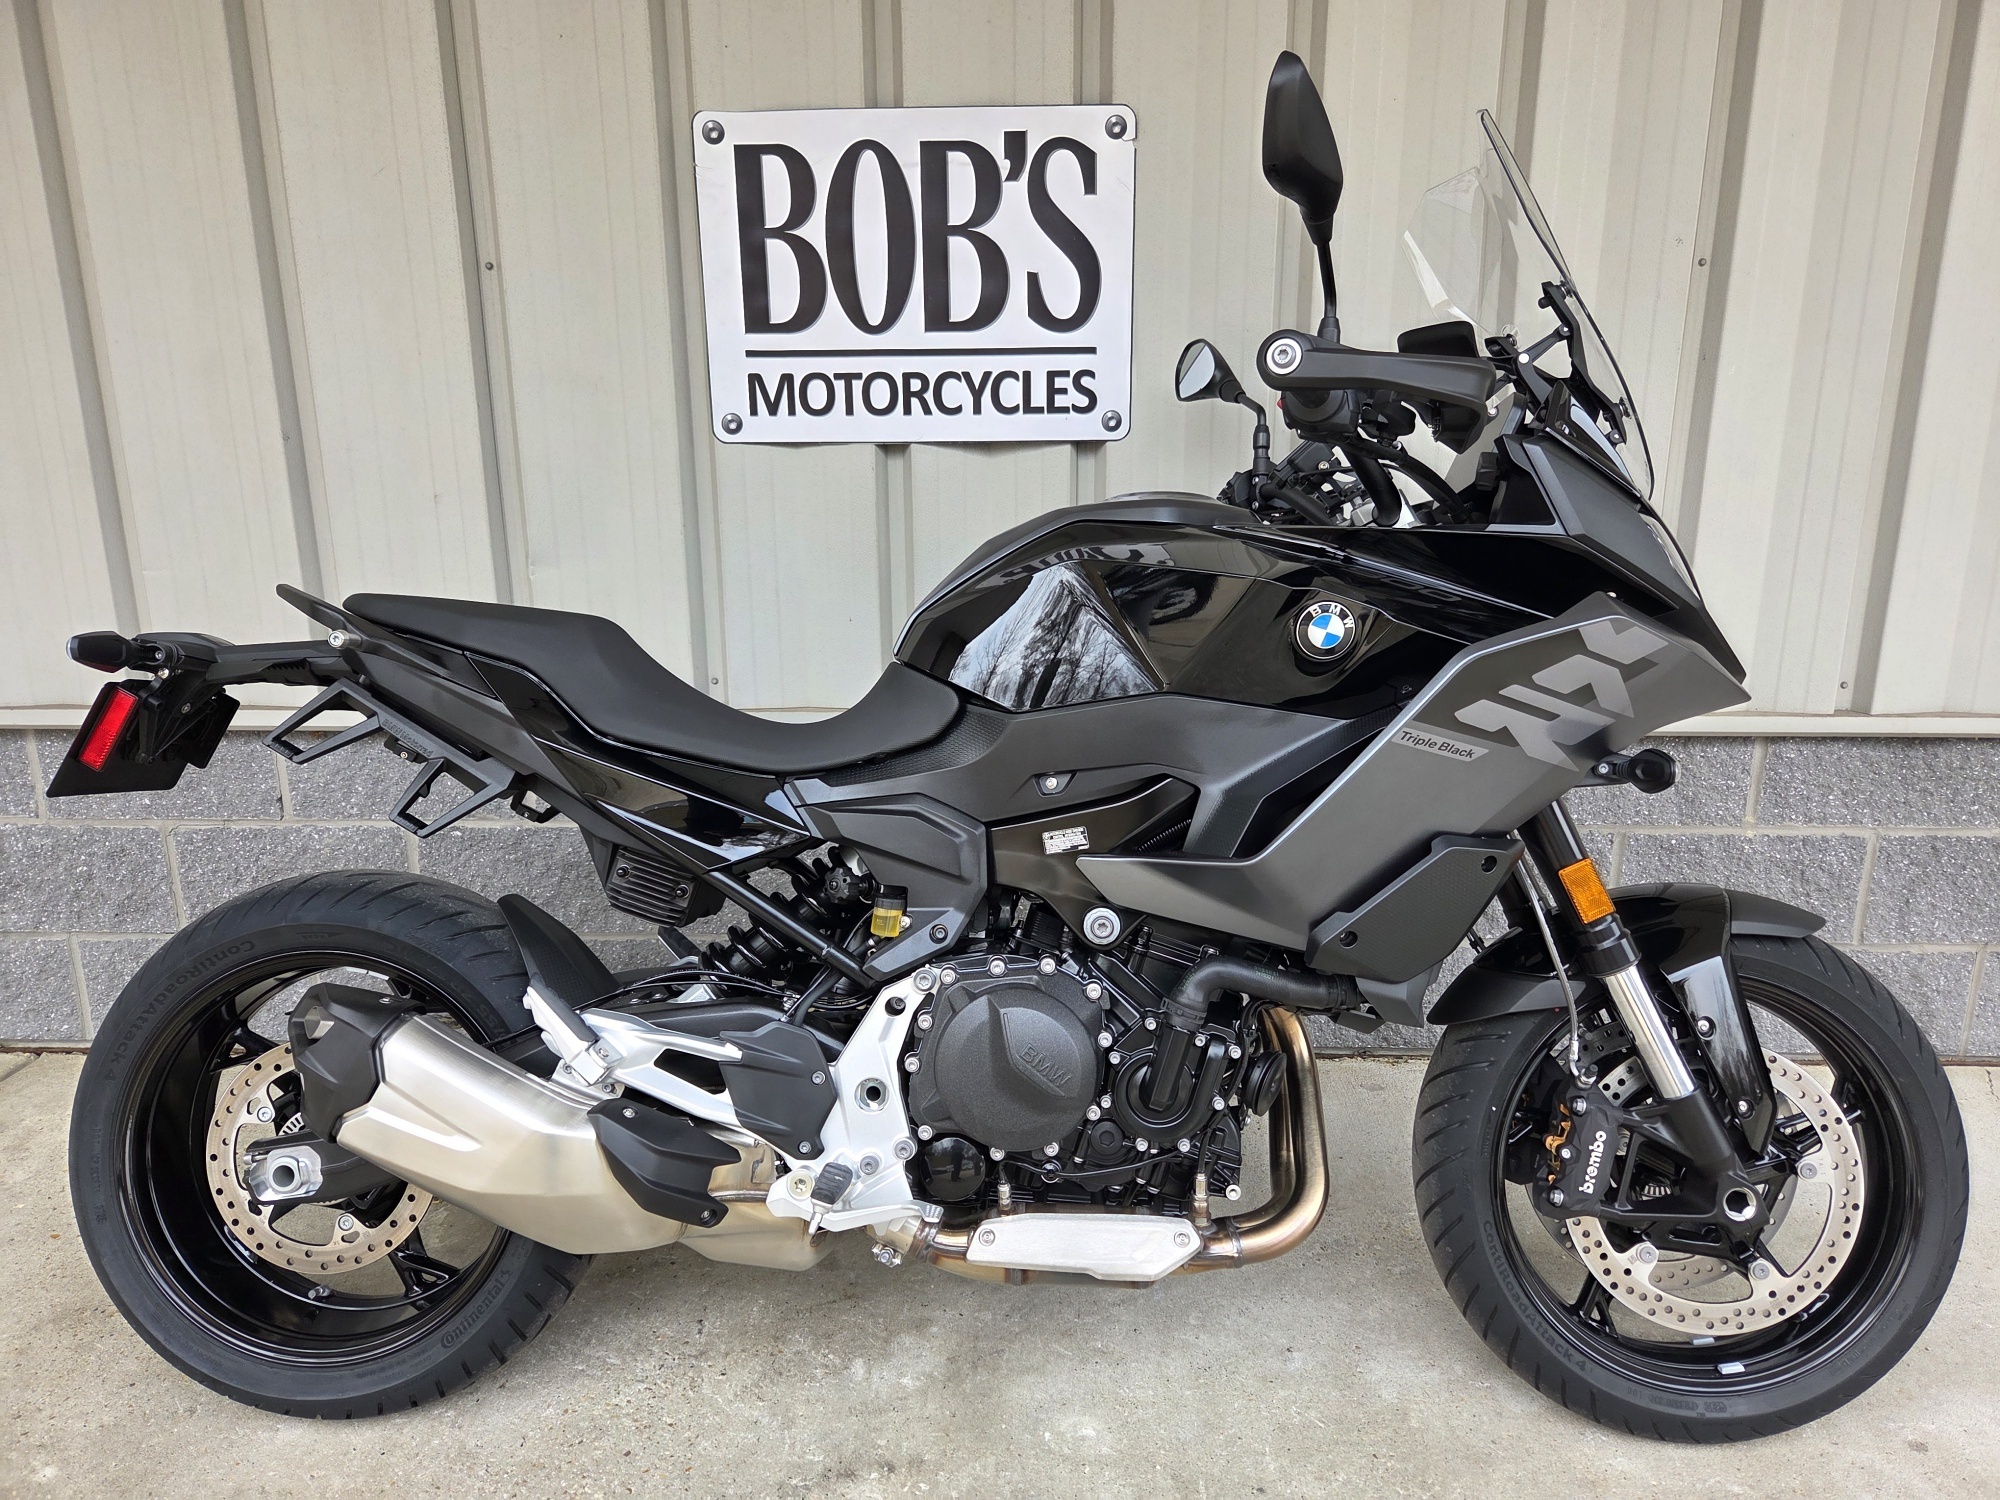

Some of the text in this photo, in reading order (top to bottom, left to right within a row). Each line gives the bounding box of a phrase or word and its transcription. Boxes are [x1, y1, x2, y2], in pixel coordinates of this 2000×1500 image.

[734, 129, 1102, 334] BOB'S
[747, 369, 1098, 416] MOTORCYCLES
[1309, 603, 1354, 628] BMW
[1400, 730, 1476, 759] Triple Black
[104, 939, 256, 1083] ContiRoadAttack 4
[1019, 1042, 1073, 1088] BMW
[1577, 1130, 1608, 1195] brembo
[440, 1277, 507, 1349] Continental
[1483, 1220, 1588, 1373] ContiRoadAttack 4
